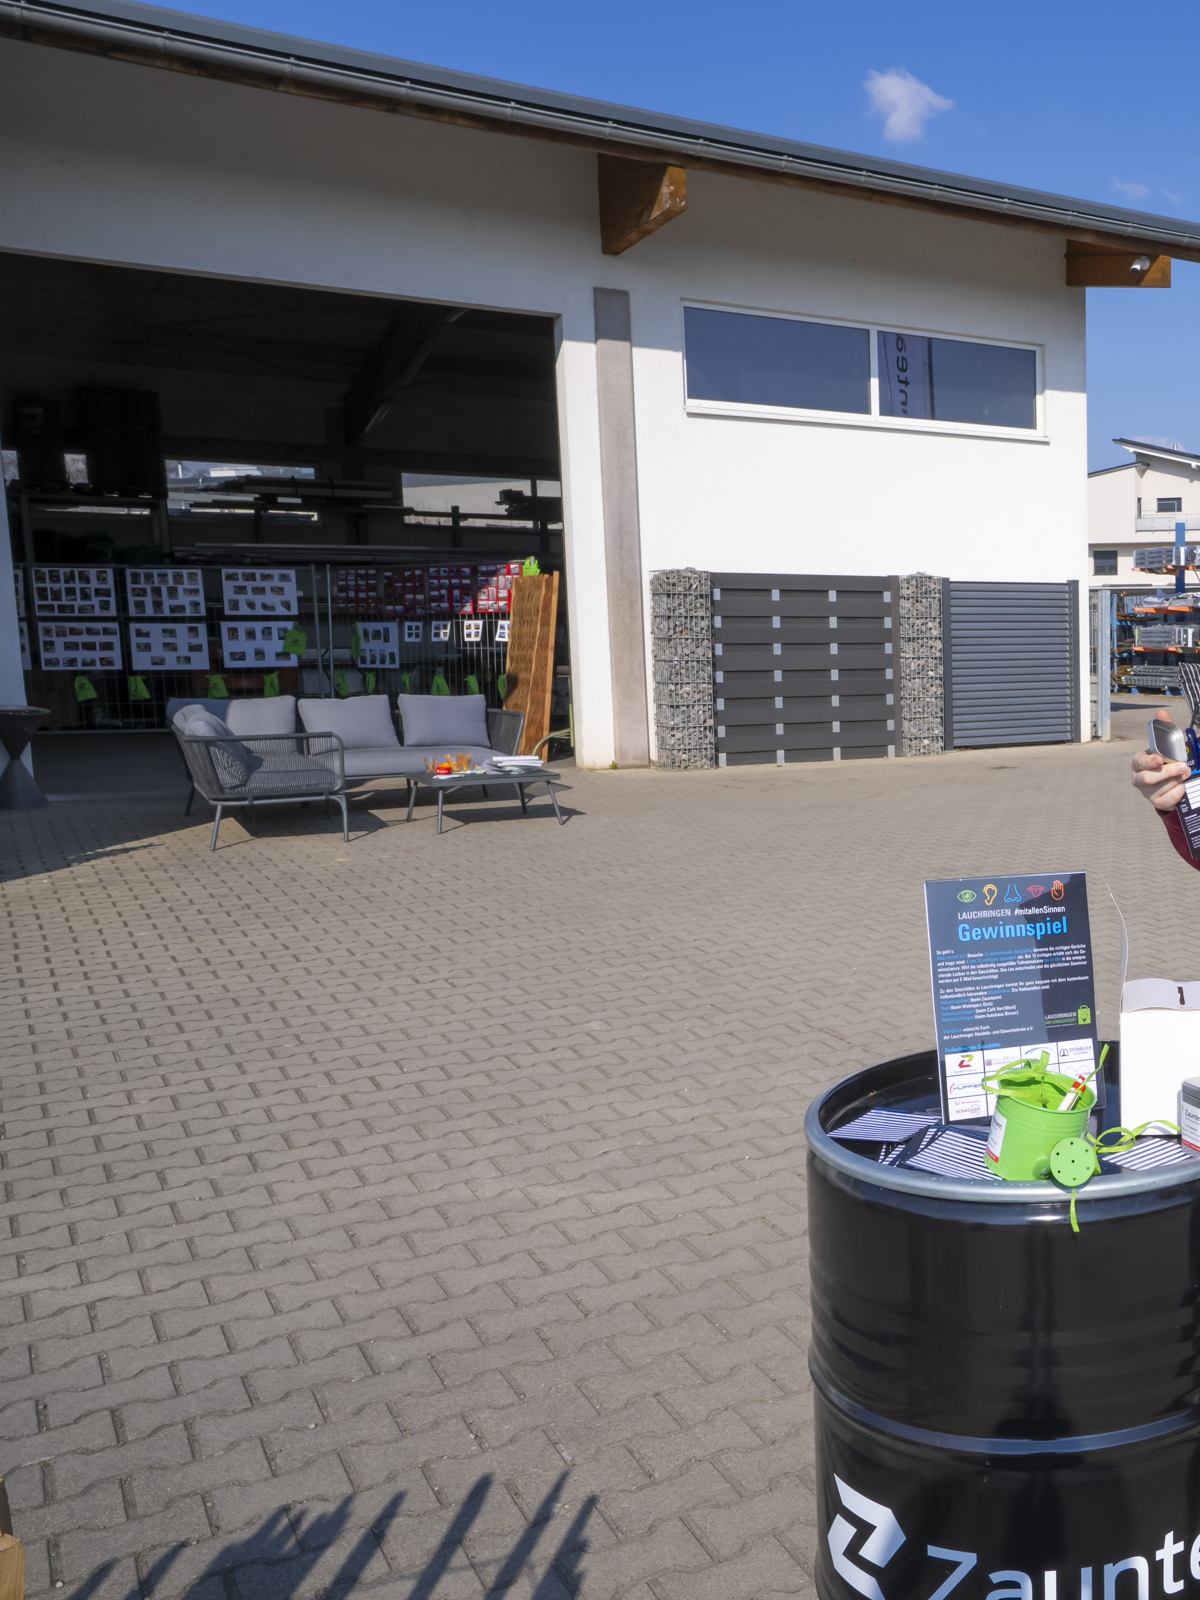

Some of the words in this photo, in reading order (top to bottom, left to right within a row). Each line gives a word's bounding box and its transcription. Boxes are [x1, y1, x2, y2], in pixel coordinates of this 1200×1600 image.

[957, 909, 1011, 920] LAUCHRINGEN
[1014, 905, 1066, 916] #mitallenSinnen
[958, 916, 1067, 942] Gewinnspiel
